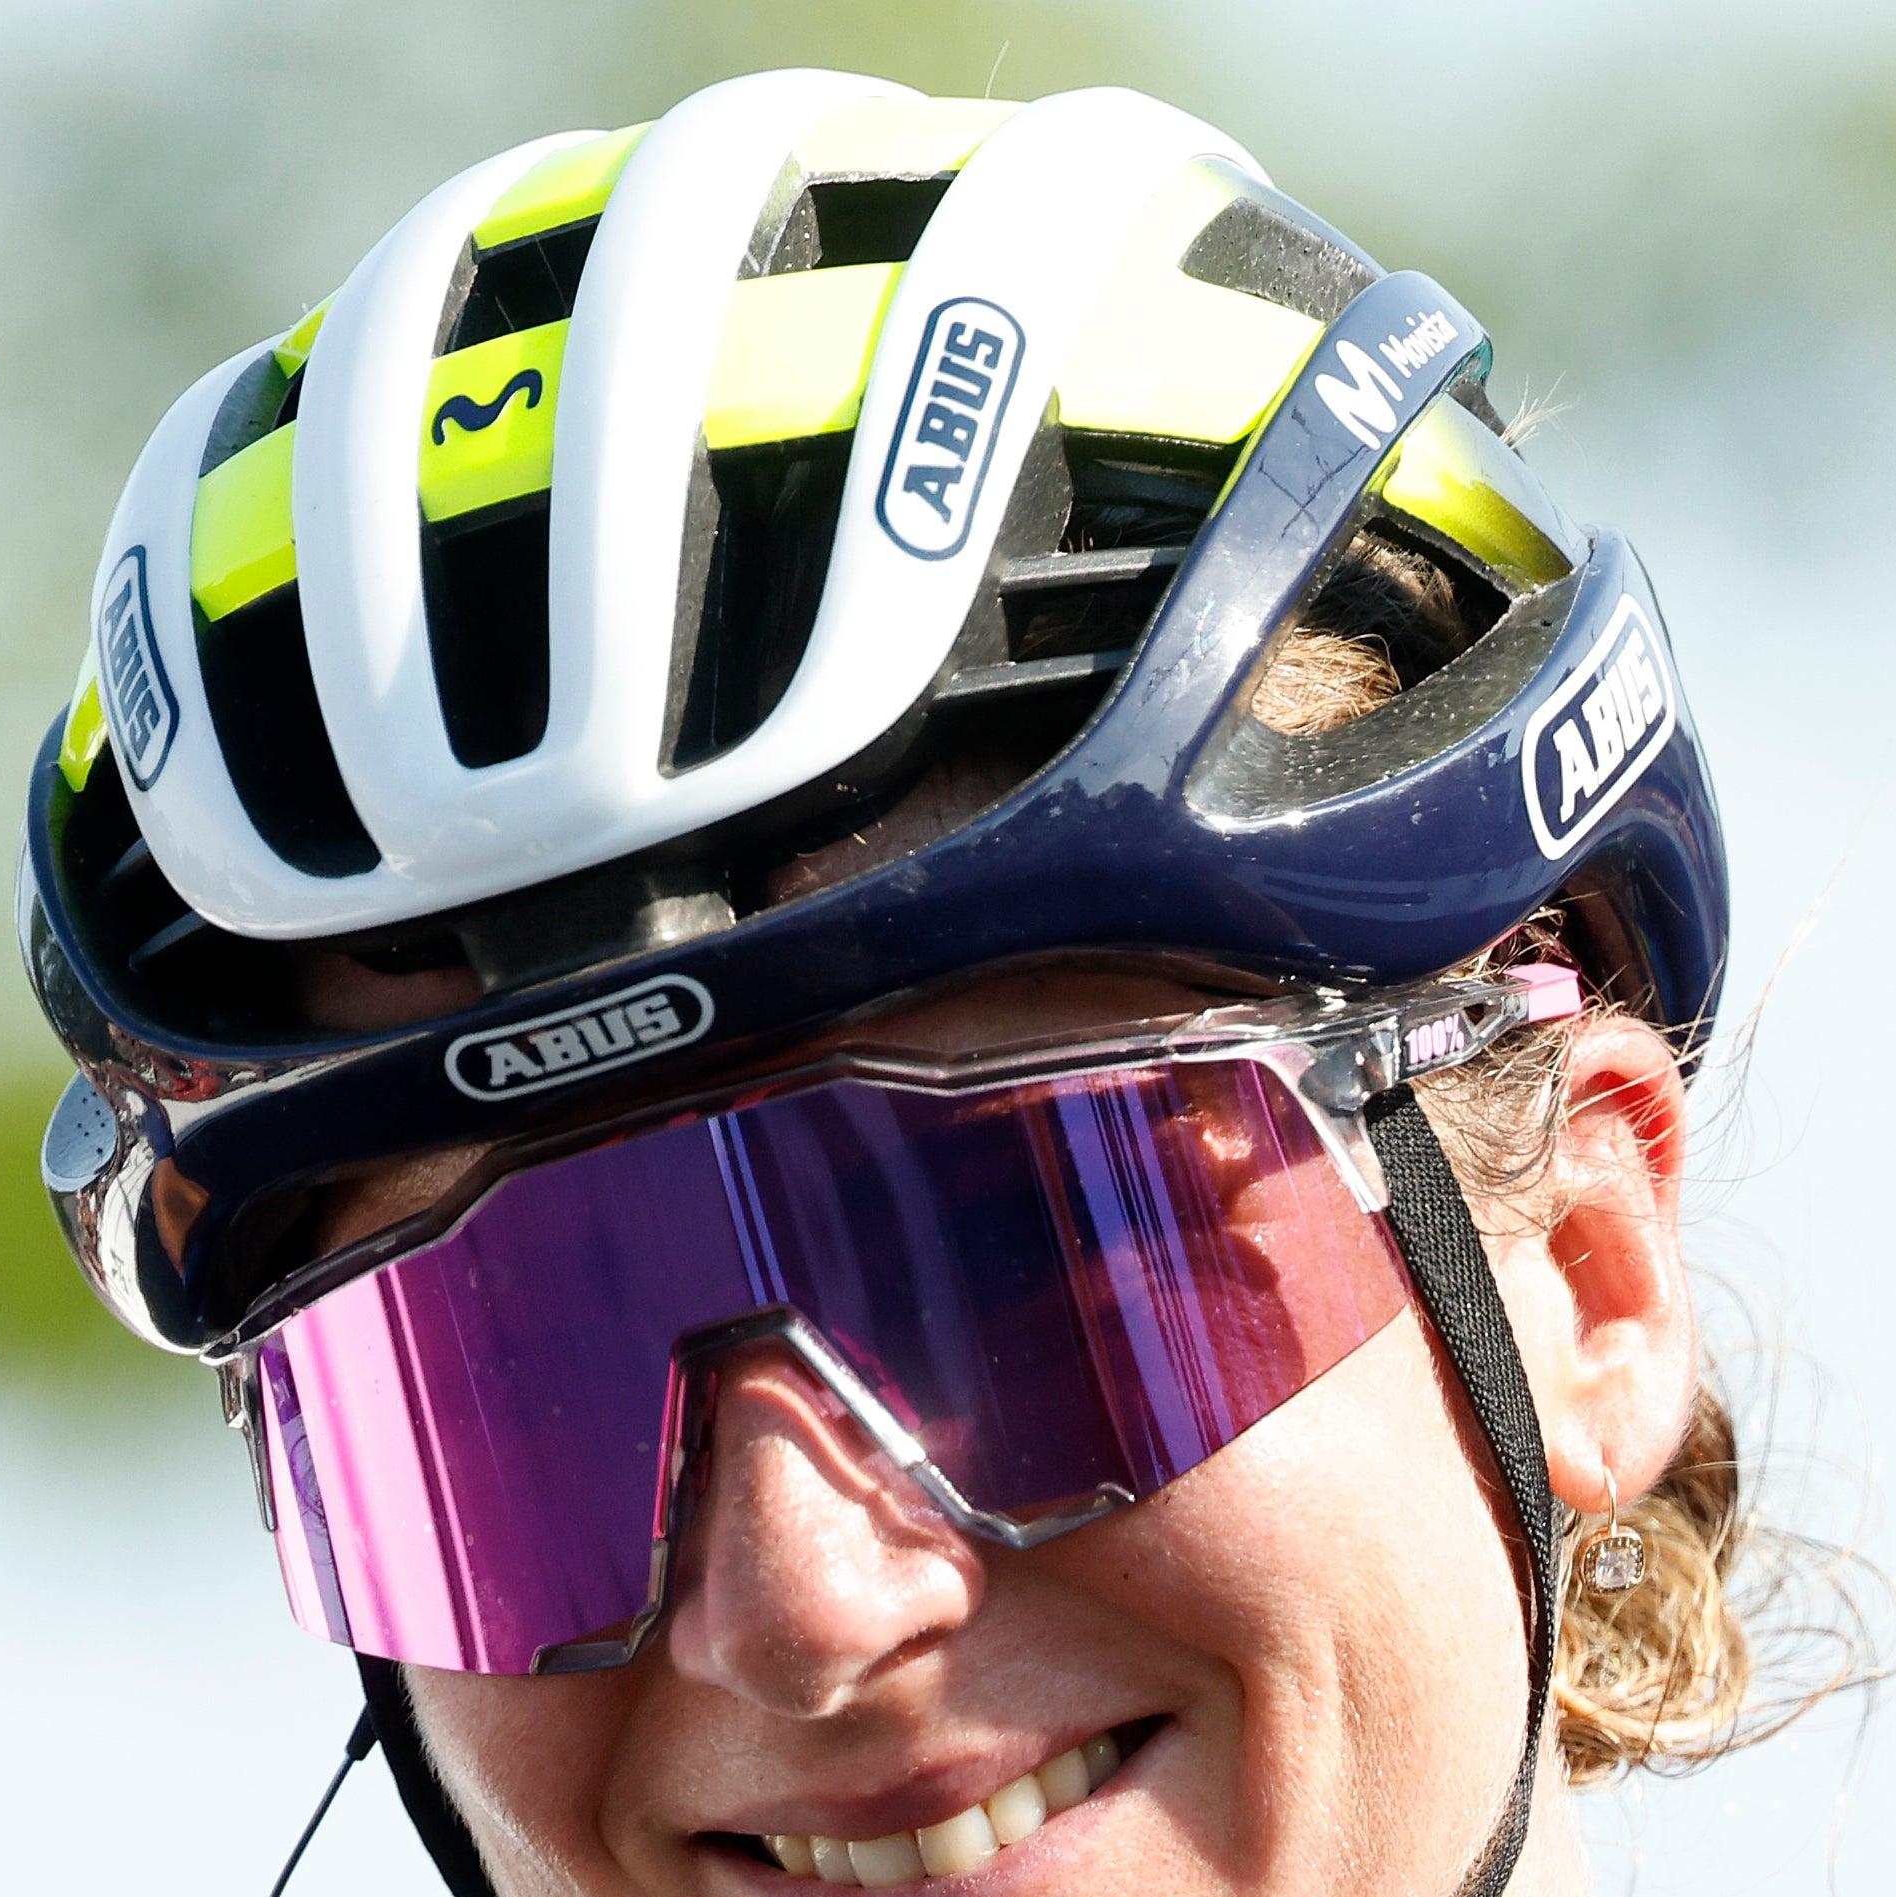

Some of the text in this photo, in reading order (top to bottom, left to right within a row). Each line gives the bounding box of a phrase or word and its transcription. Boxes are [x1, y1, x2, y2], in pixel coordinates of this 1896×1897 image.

[903, 321, 1005, 525] ABUS
[104, 577, 161, 762] ABUS
[1552, 627, 1664, 824] ABUS
[484, 992, 682, 1087] ABUS
[1404, 1013, 1466, 1065] 100%
